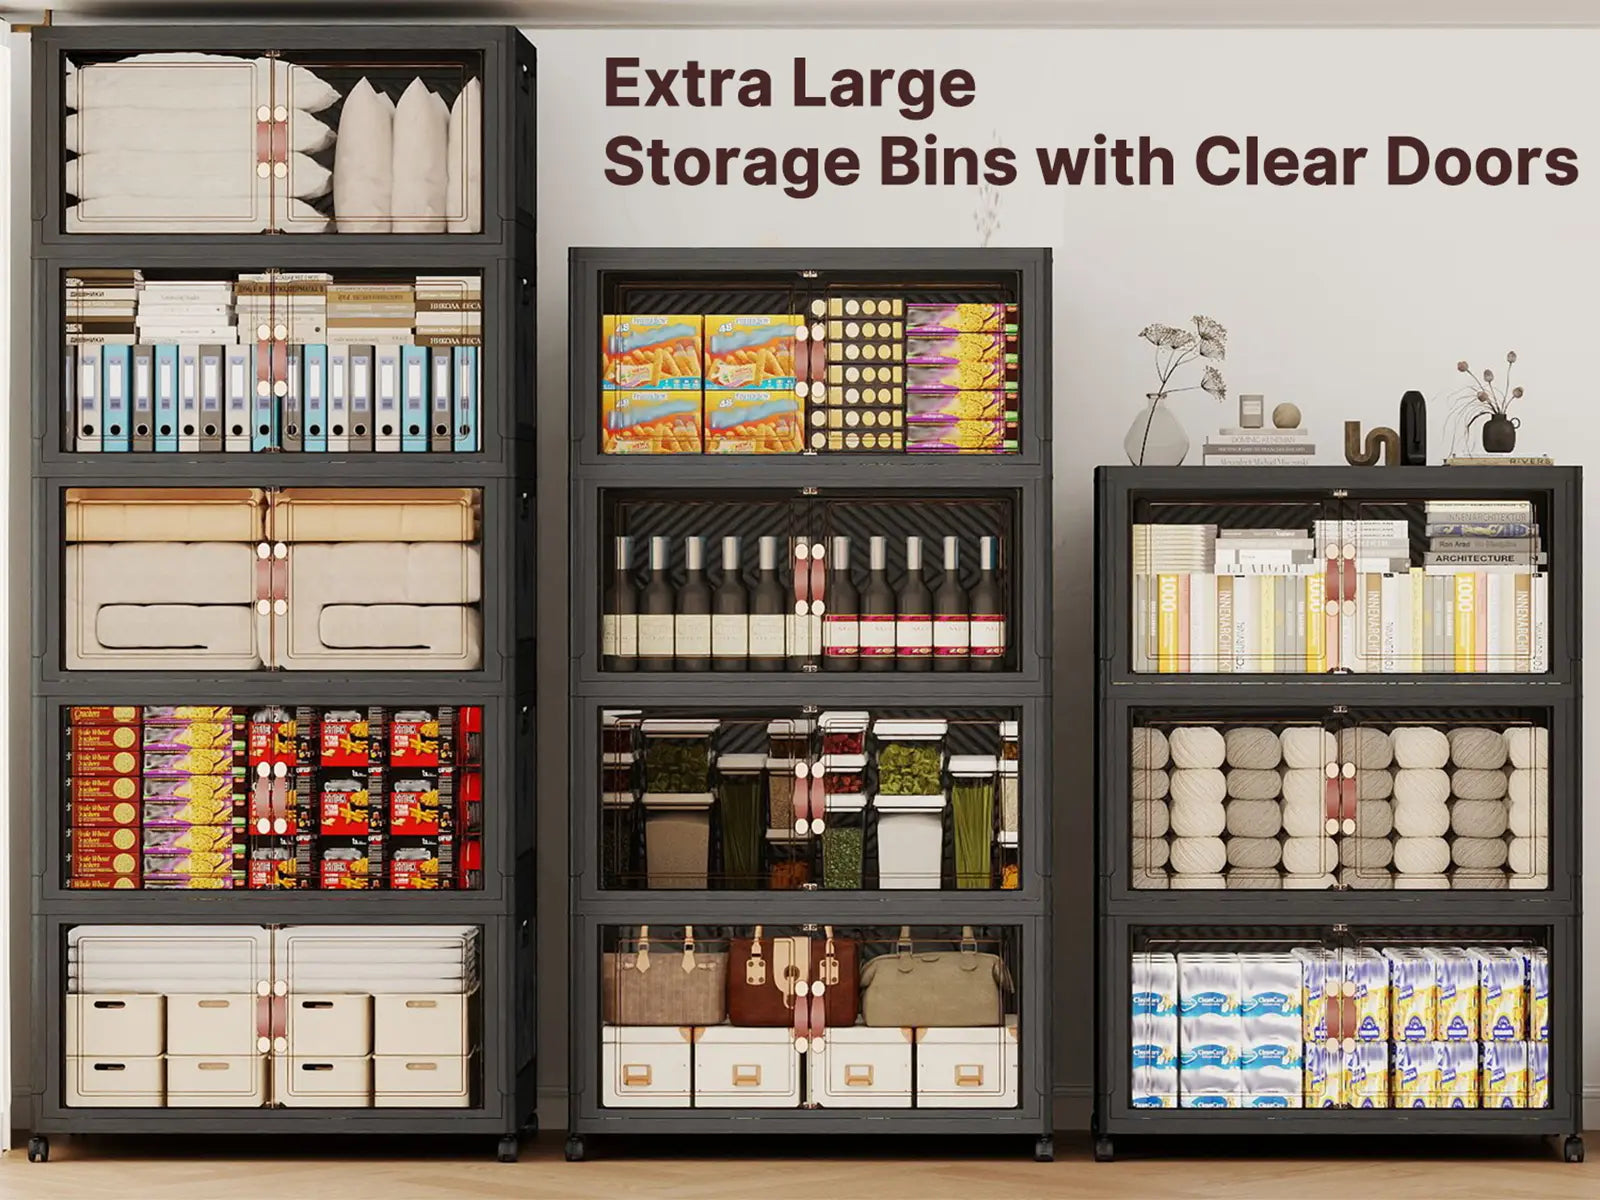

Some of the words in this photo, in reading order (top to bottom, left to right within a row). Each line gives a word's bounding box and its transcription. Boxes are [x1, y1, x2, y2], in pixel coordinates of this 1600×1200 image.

[1509, 457, 1551, 465] RIVERS
[1440, 540, 1453, 548] Ron
[1454, 540, 1471, 548] Arad
[1435, 554, 1515, 563] ARCHITECTURE
[1161, 576, 1177, 613] 1000
[1458, 577, 1473, 613] 1000
